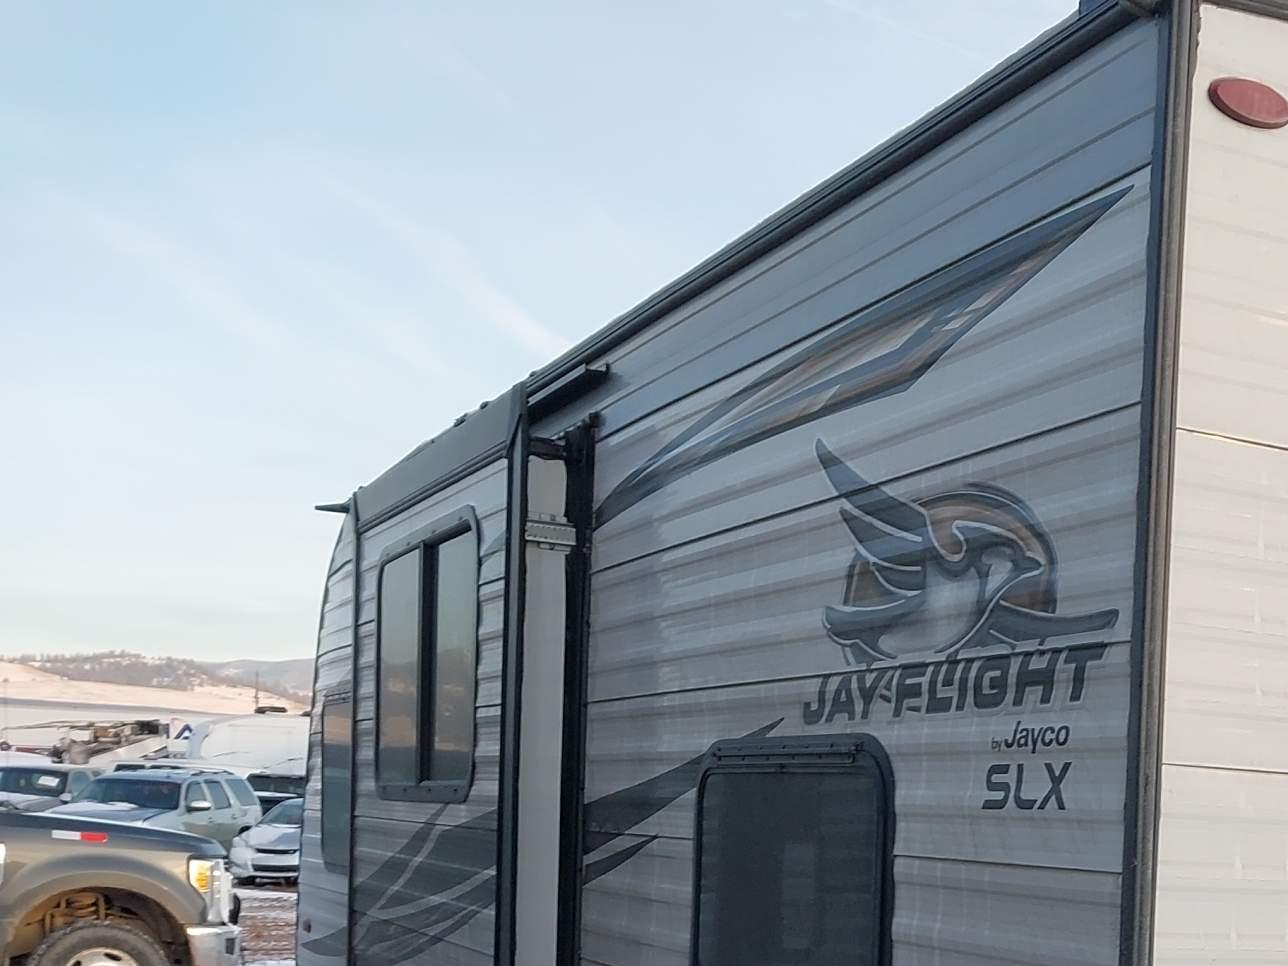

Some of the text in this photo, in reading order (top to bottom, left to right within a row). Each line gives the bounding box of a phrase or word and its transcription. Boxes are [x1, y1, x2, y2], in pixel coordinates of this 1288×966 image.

[803, 643, 1107, 725] JAY FLIGHT
[990, 720, 1071, 754] by Jayco
[981, 761, 1073, 811] SLX
